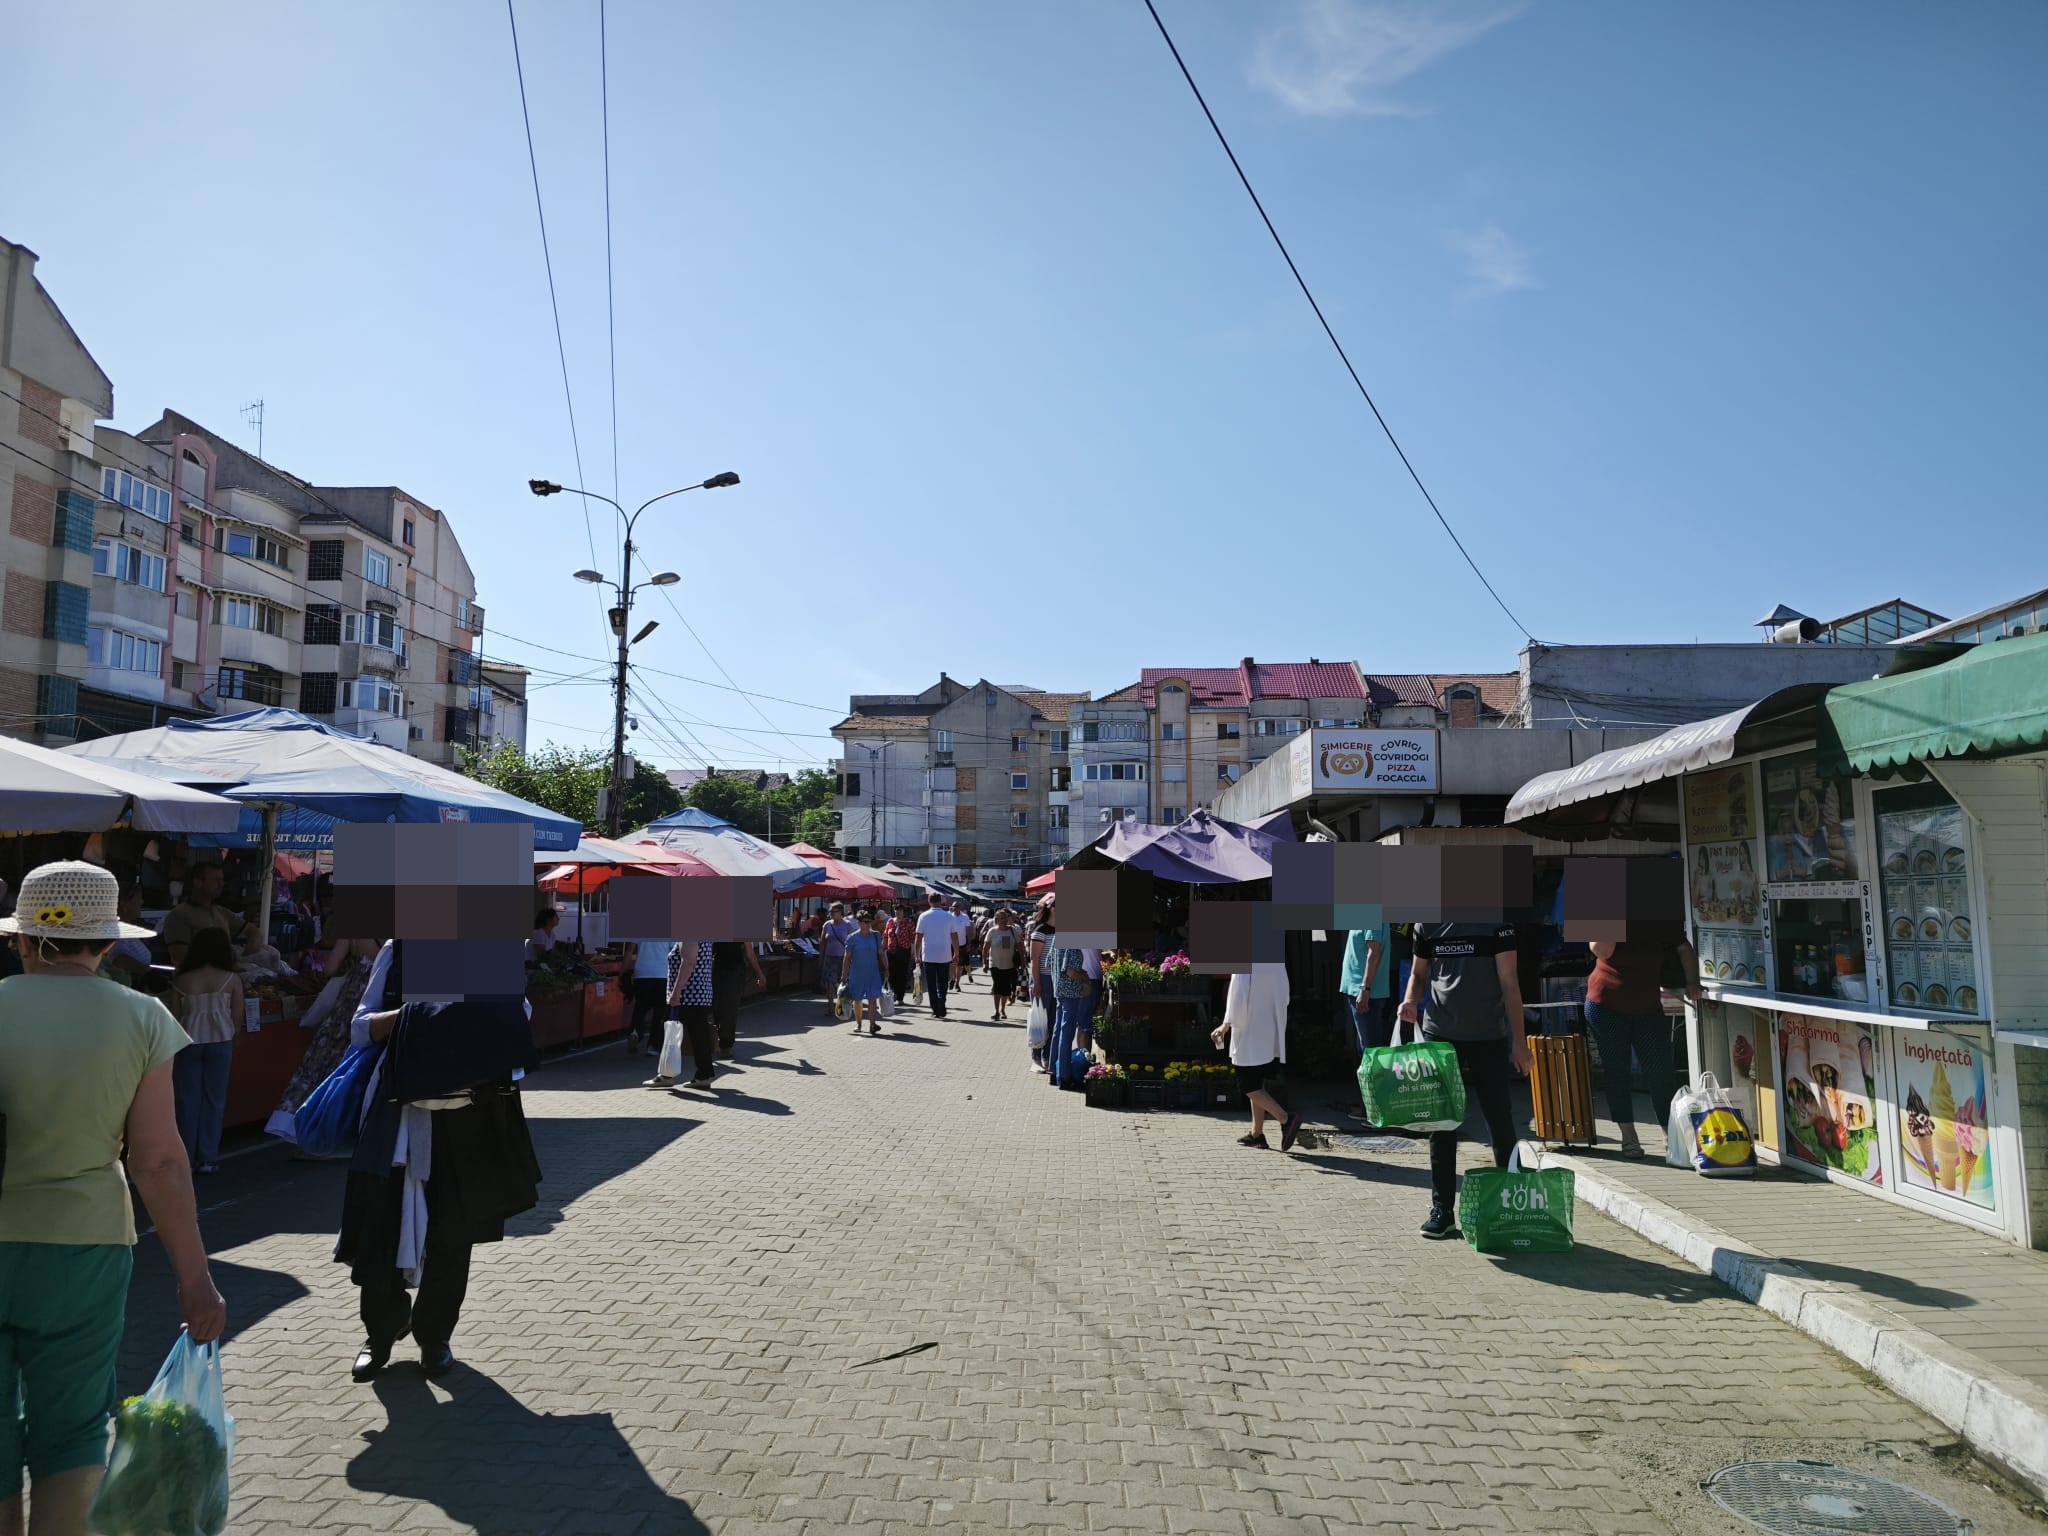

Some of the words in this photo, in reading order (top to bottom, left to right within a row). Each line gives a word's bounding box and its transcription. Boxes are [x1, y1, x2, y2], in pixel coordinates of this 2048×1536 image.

[1320, 742, 1373, 752] SIMIGERIE
[1380, 739, 1422, 753] COVRIGI
[1374, 753, 1429, 762] COVRIDOGI
[1387, 764, 1416, 772] PIZZA
[1376, 774, 1427, 783] FOCACCIA
[982, 874, 1006, 884] BAR
[1862, 884, 1873, 949] SIROP
[1435, 943, 1475, 953] BROOKLYN
[1786, 1020, 1841, 1044] Shaorma
[1398, 1083, 1410, 1093] chi
[1499, 1212, 1513, 1221] chi
